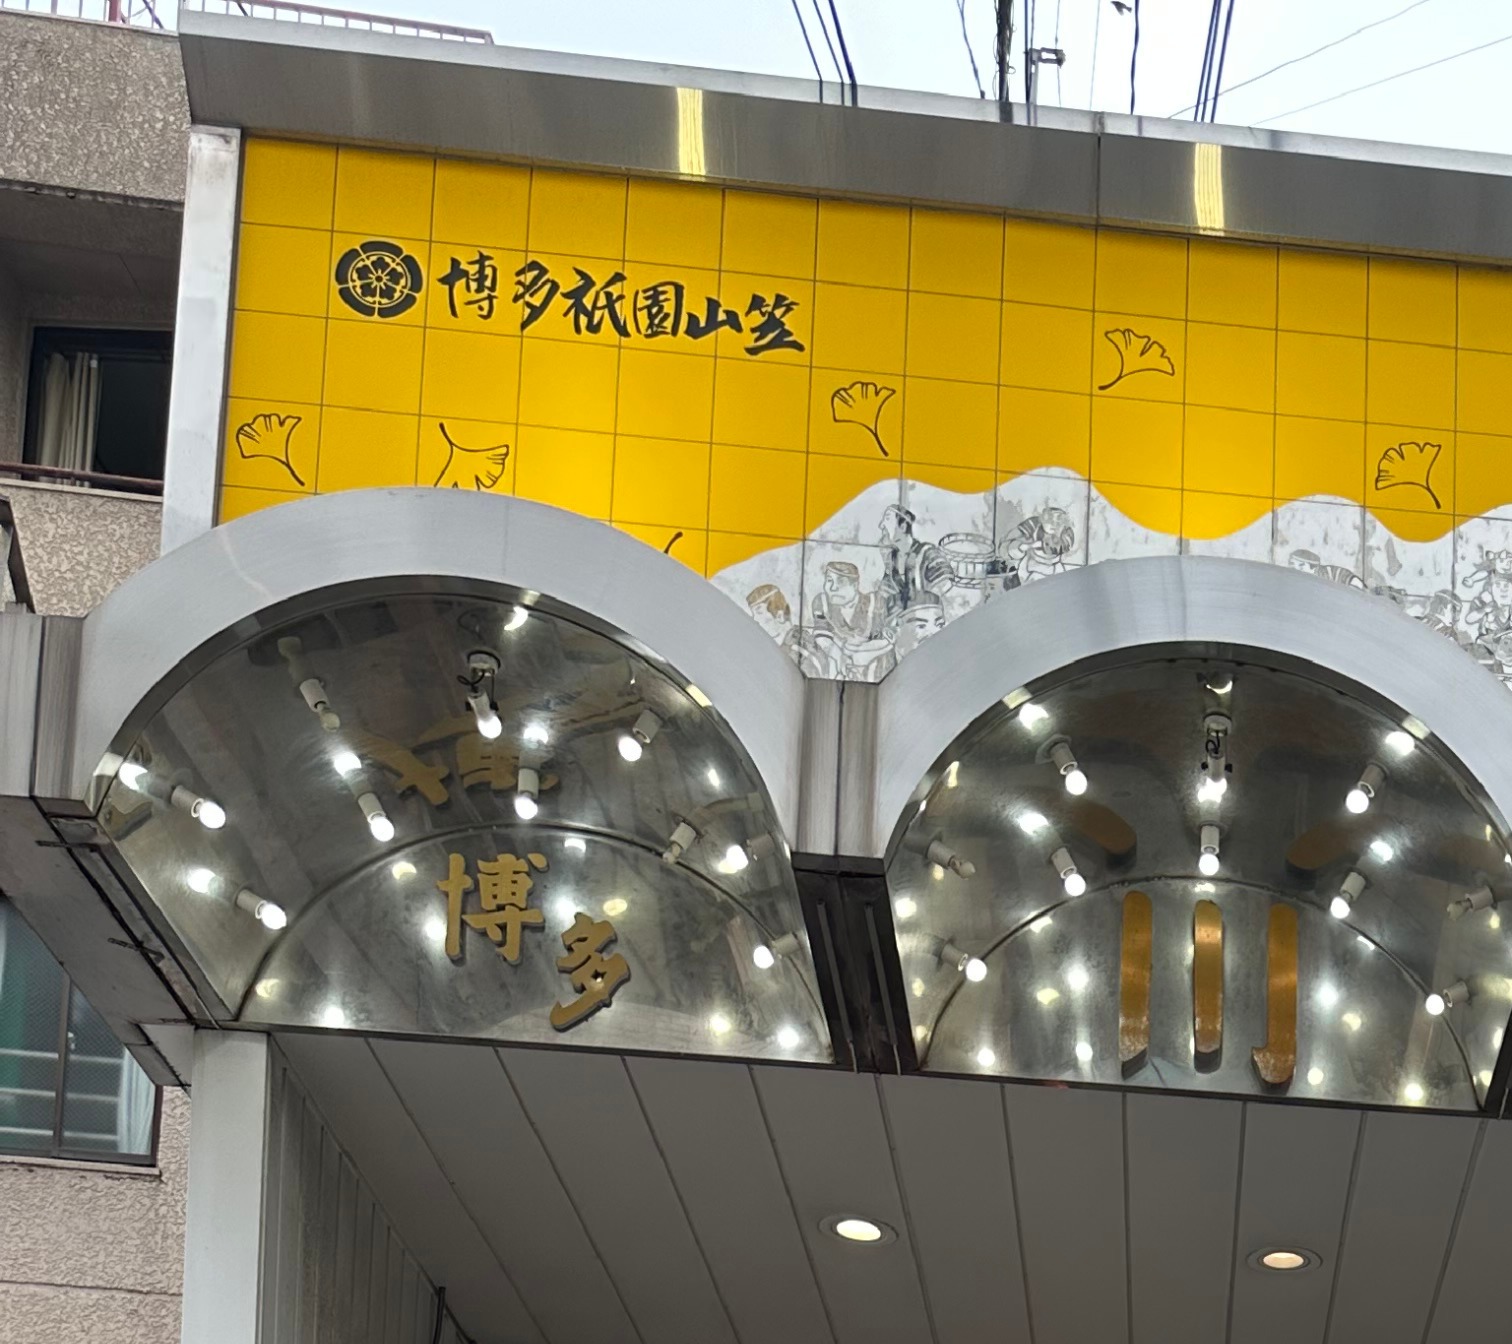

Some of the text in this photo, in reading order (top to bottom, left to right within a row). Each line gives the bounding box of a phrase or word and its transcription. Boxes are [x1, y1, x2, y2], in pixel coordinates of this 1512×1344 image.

[437, 250, 806, 356] 博多祇園山笠
[436, 852, 632, 1032] 博多
[1117, 889, 1299, 1096] 川
